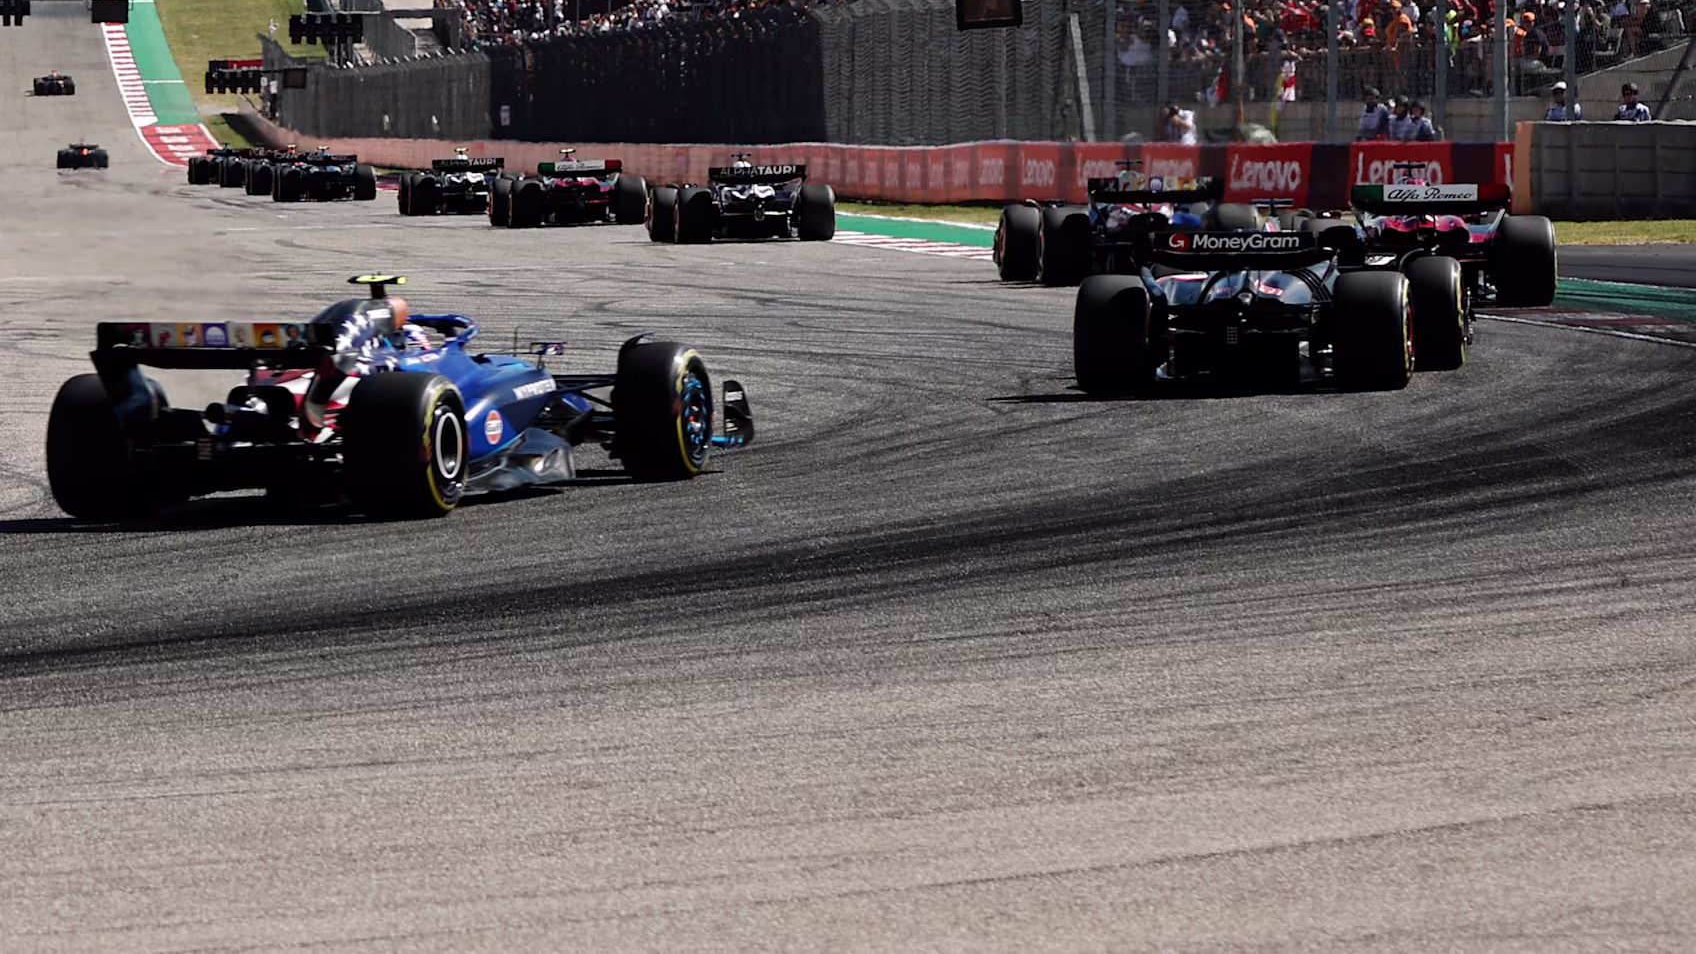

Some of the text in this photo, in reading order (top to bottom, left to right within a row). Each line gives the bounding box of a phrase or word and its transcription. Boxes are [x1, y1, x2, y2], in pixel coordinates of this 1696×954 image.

[720, 165, 797, 177] ALPHATAURI
[1021, 151, 1055, 187] Lenovo
[1230, 153, 1302, 191] Lenovo
[1387, 187, 1474, 201] Alfa Romeo
[1192, 233, 1300, 252] MoneyGram
